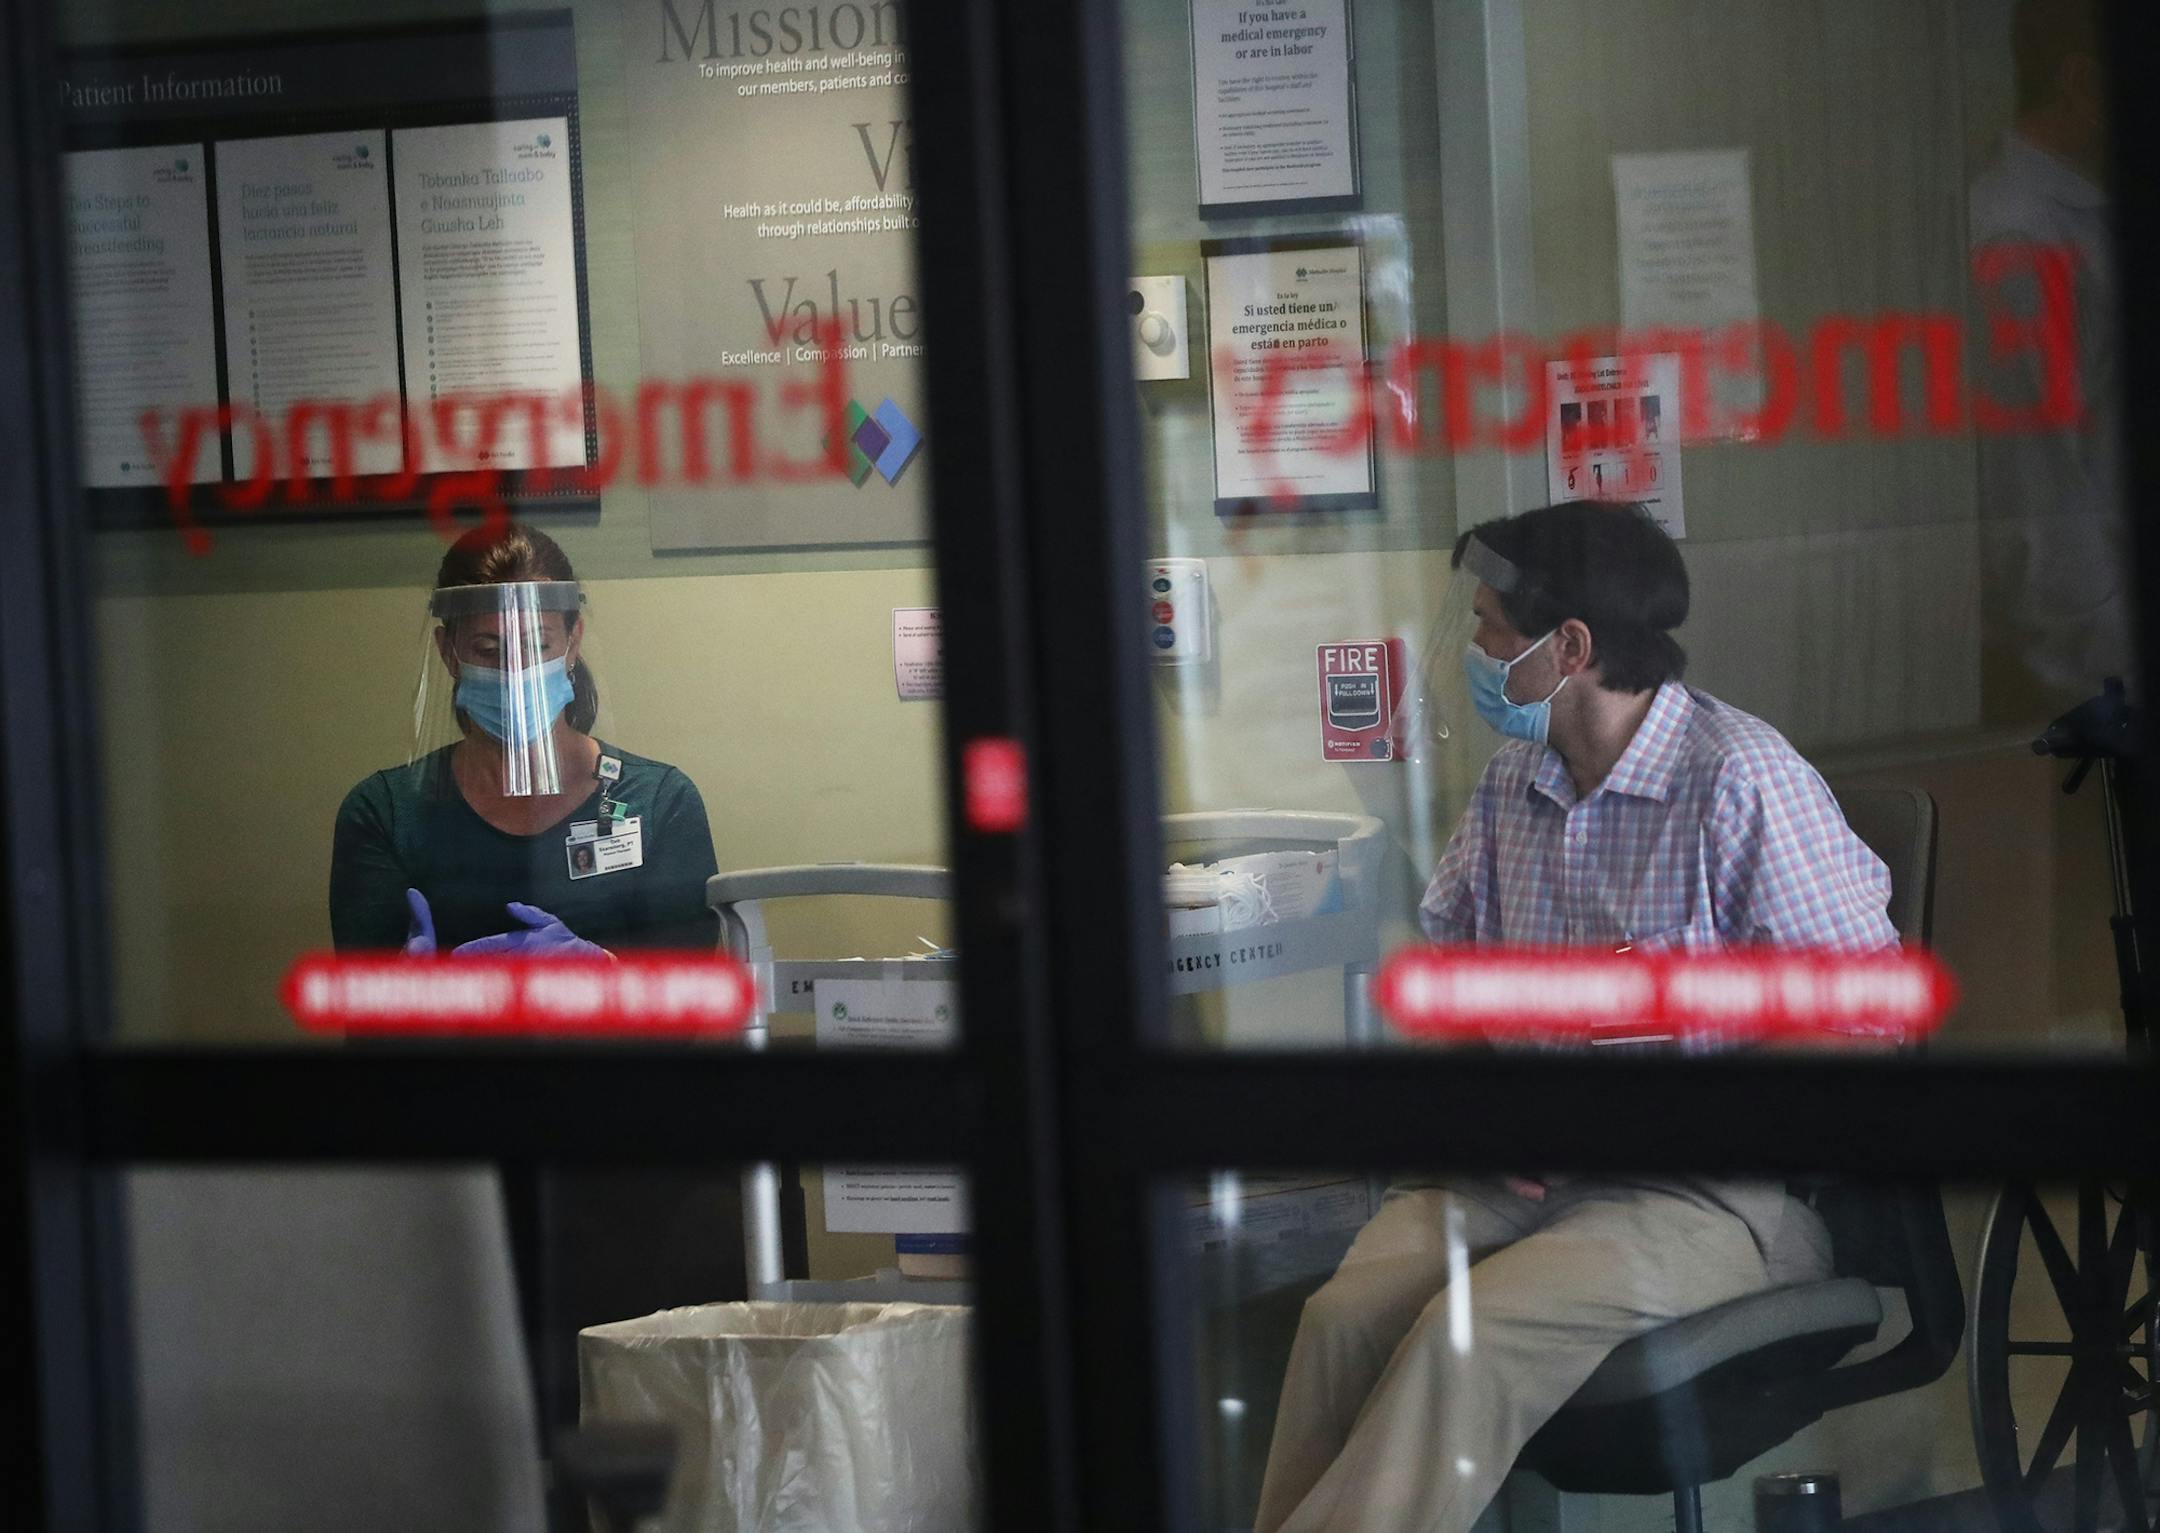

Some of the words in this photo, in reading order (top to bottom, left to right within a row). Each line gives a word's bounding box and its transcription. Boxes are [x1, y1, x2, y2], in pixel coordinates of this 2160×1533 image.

[1239, 12, 1247, 24] If
[1249, 14, 1269, 26] you
[1271, 9, 1297, 21] have
[1300, 10, 1306, 19] a
[656, 0, 907, 63] Mission
[1221, 28, 1264, 42] medical
[1266, 26, 1327, 41] emergency
[1235, 49, 1248, 59] or
[1250, 48, 1268, 58] are
[1270, 46, 1281, 57] in
[1284, 44, 1313, 56] labor
[699, 64, 714, 78] To
[716, 62, 763, 80] improve
[766, 57, 801, 74] health
[805, 55, 828, 71] and
[830, 51, 892, 69] well-being
[58, 78, 133, 107] Patient
[143, 68, 283, 102] Information
[737, 83, 757, 96] our
[760, 77, 818, 94] members,
[820, 75, 867, 93] patients
[870, 72, 891, 86] and
[724, 202, 761, 219] Health
[764, 206, 777, 216] as
[779, 201, 788, 215] it
[790, 199, 822, 214] could
[824, 197, 843, 214] be,
[845, 192, 914, 212] affordability
[479, 213, 504, 231] Leh
[757, 220, 804, 239] through
[807, 217, 881, 236] relationships
[883, 214, 909, 230] built
[1244, 304, 1254, 316] Si
[1257, 303, 1286, 316] usted
[1288, 303, 1316, 314] tiene
[1232, 320, 1295, 336] emergencia
[1298, 318, 1337, 331] médica
[1340, 319, 1347, 328] o
[1283, 339, 1296, 349] en
[1298, 336, 1329, 350] parto
[722, 349, 782, 365] Excellence
[796, 346, 867, 363] Compassion
[1325, 648, 1378, 672] FIRE
[1230, 943, 1282, 964] CENTER
